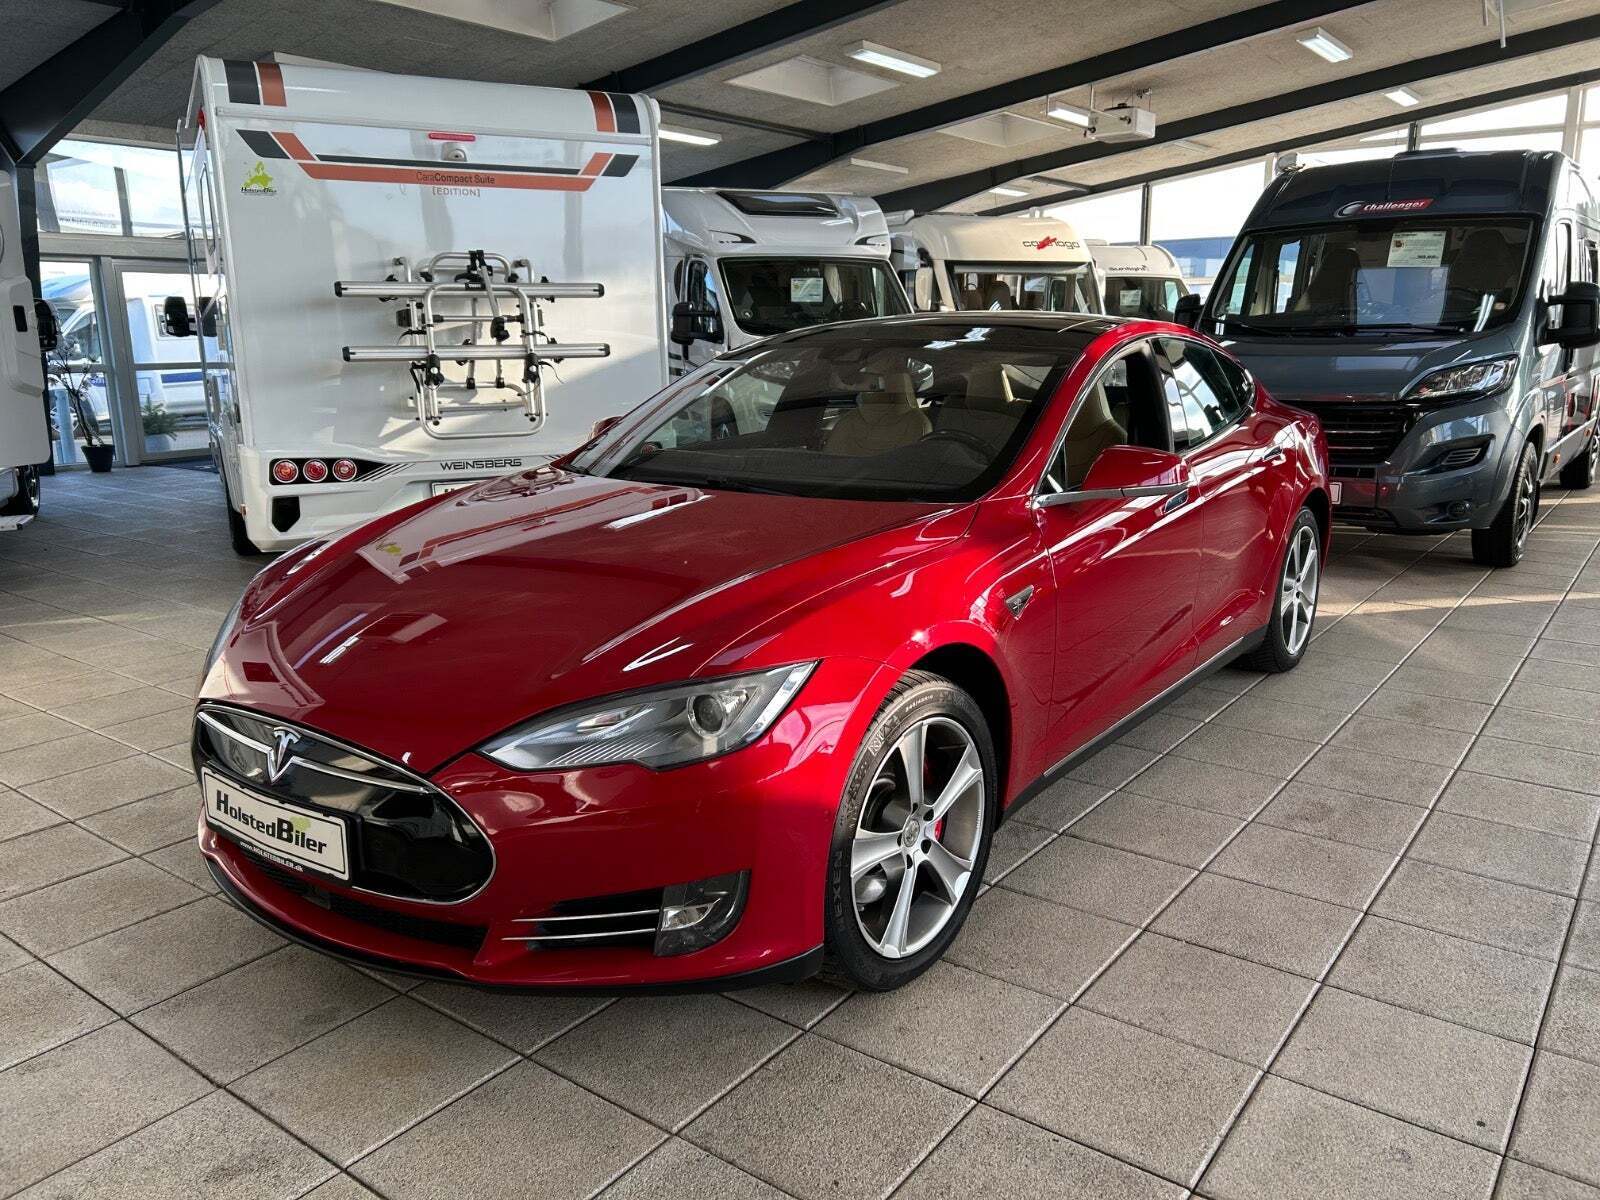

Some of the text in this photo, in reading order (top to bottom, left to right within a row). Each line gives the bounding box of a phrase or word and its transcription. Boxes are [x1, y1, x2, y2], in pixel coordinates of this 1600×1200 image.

[416, 171, 496, 185] CaraCompact Suite
[440, 458, 523, 471] WEINSBERG
[216, 789, 327, 854] HolstedBiler
